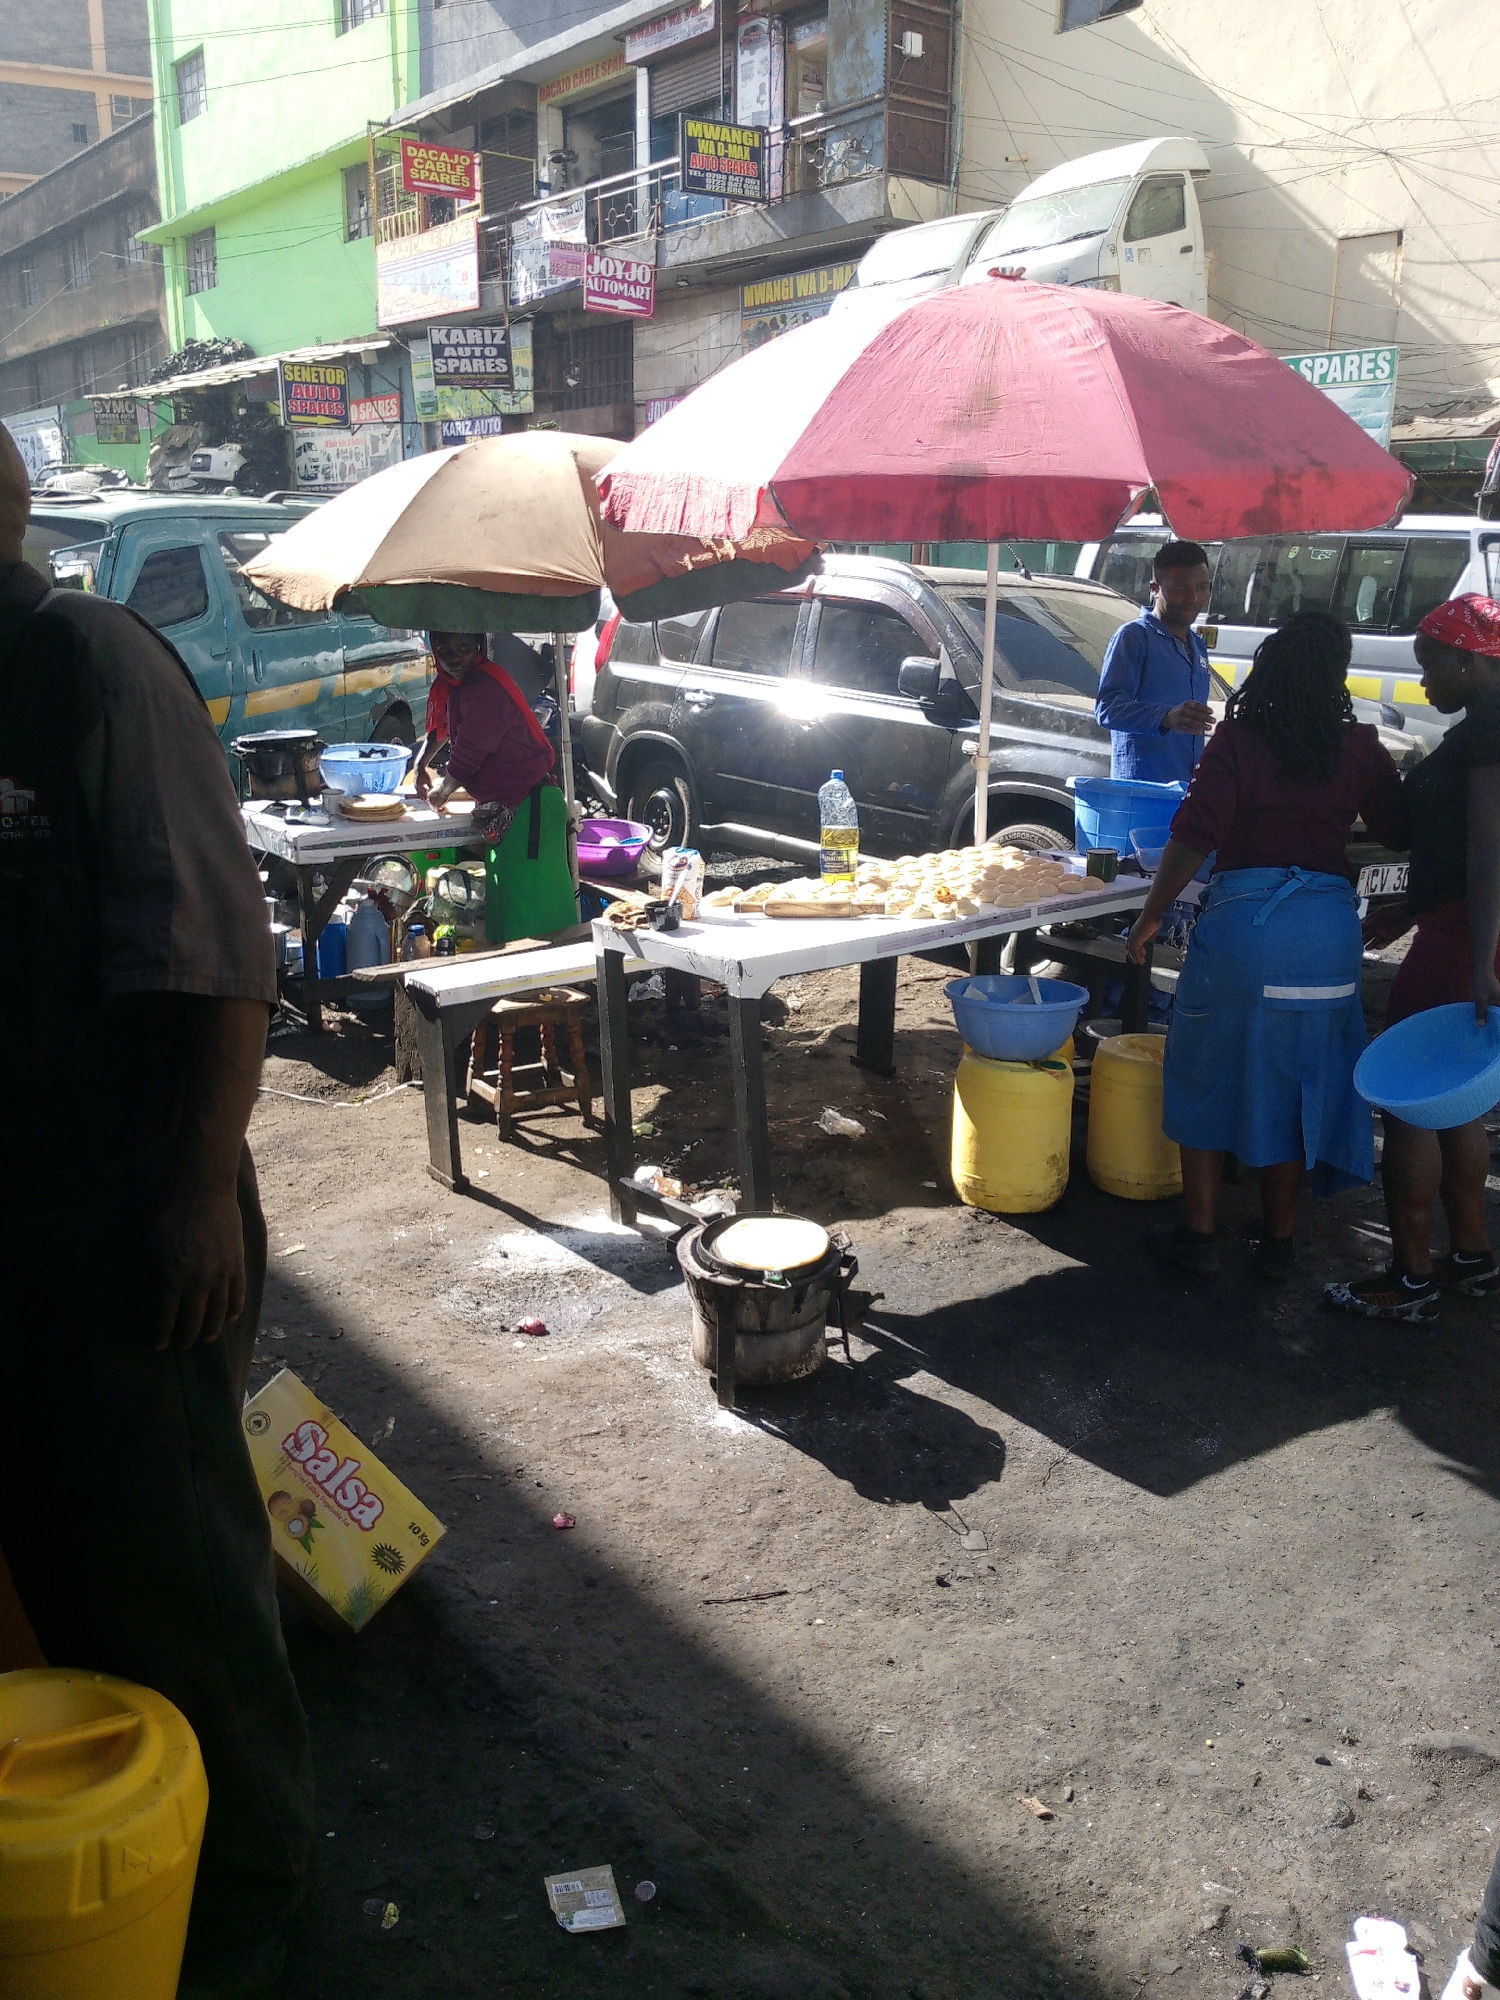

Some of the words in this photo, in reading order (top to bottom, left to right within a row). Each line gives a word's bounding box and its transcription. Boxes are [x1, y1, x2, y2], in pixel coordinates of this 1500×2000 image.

[572, 64, 600, 88] CABLE
[601, 54, 628, 76] SPAR
[687, 122, 760, 148] MWANGI
[406, 146, 472, 167] DACAJO
[698, 138, 716, 155] WA
[717, 141, 751, 161] D-MAX
[413, 158, 466, 177] CABLE
[690, 152, 718, 172] AUTO
[720, 157, 758, 177] SPARES
[410, 168, 471, 188] SPARES
[411, 232, 439, 255] CABLE
[440, 221, 475, 248] SPARES
[586, 256, 652, 285] JOYJO
[586, 276, 652, 301] AUTOMART
[743, 276, 794, 308] MWANGI
[796, 271, 817, 297] WA
[431, 328, 506, 345] KARIZ
[443, 346, 498, 357] AUTO
[283, 364, 346, 386] SENETOR
[434, 358, 509, 374] SPARES
[1299, 350, 1392, 385] SPARES
[291, 383, 341, 401] AUTO
[93, 399, 135, 413] SYMO
[288, 400, 346, 416] SPARES
[360, 398, 398, 421] SPARES
[443, 421, 472, 437] KARIZ
[474, 417, 503, 435] AUTO
[281, 1420, 385, 1532] Salsa
[407, 1521, 421, 1538] 10
[418, 1532, 430, 1547] Kg
